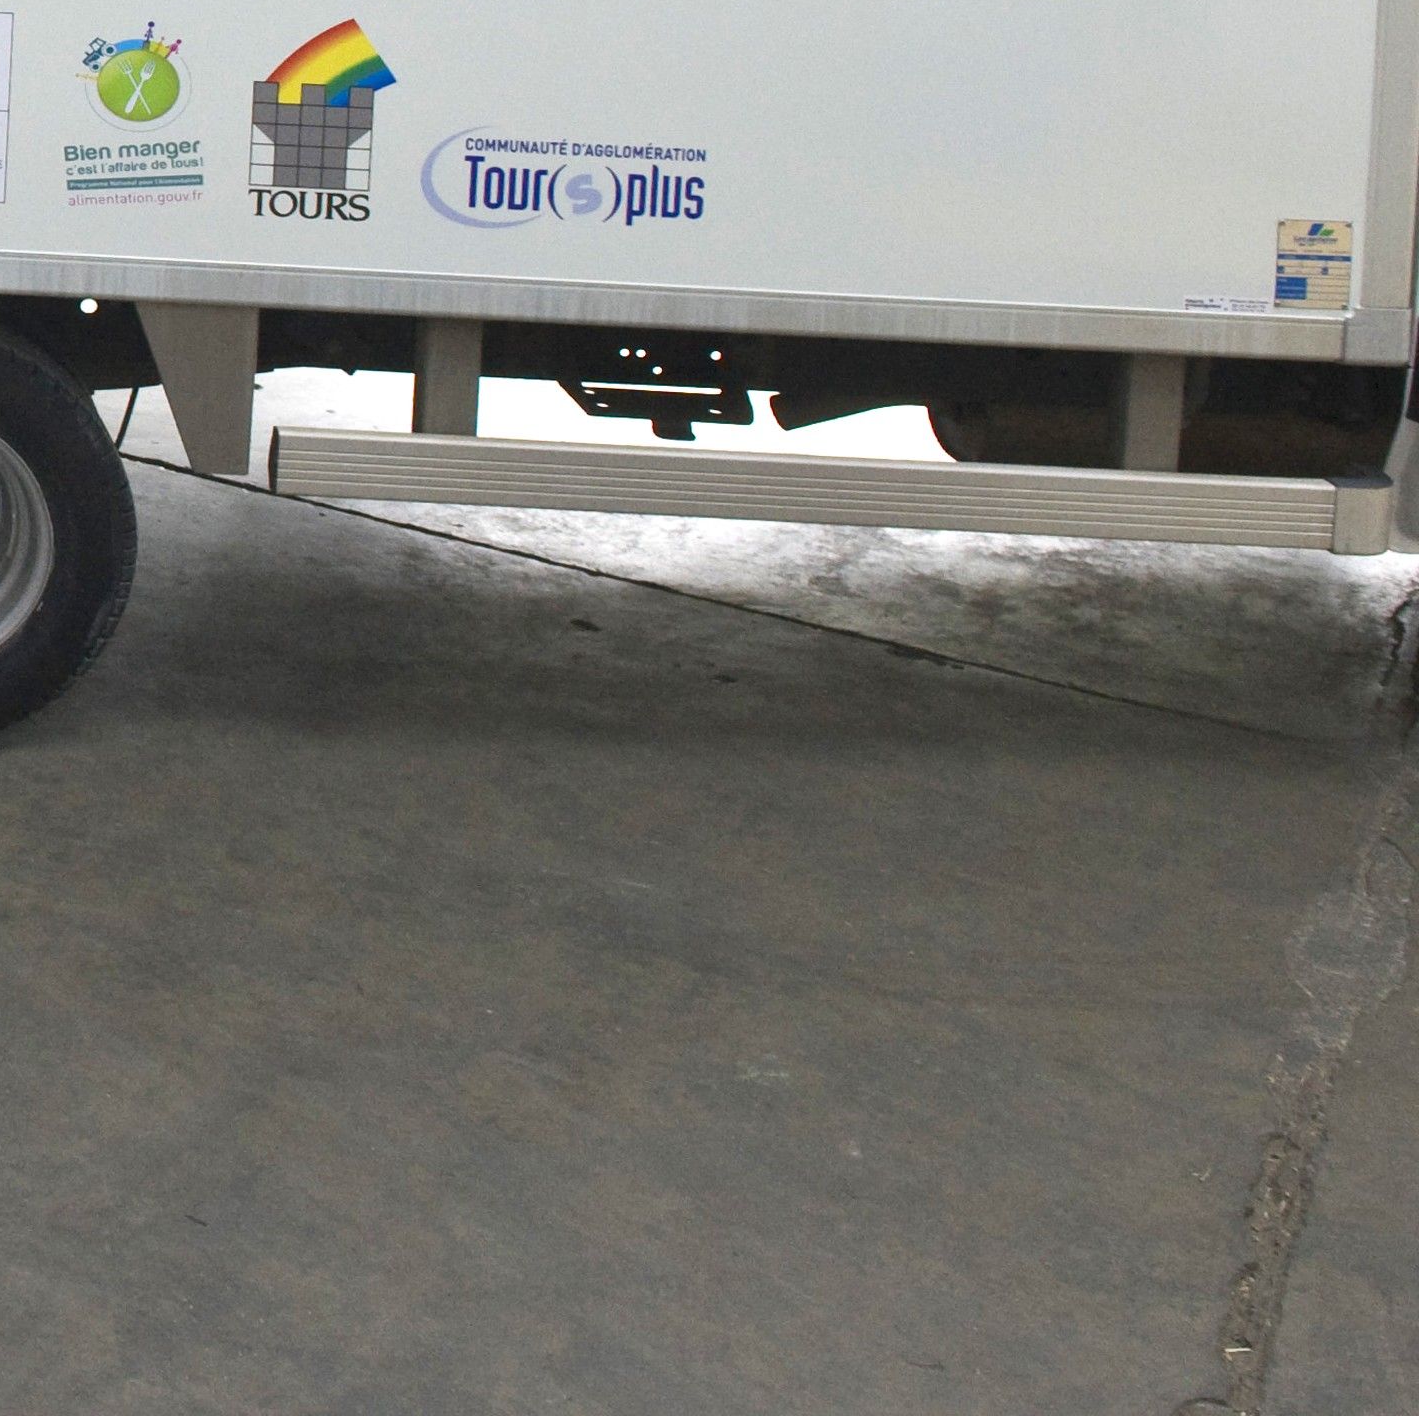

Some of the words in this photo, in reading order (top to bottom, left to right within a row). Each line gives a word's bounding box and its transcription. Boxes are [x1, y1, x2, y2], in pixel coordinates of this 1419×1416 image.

[64, 145, 112, 162] Bien
[118, 140, 201, 159] manger
[465, 137, 568, 156] COMMUNAUTÉ
[572, 142, 707, 162] D'AGGLOMÉRATION
[66, 164, 97, 176] c'est
[101, 161, 147, 173] l'affaire
[151, 160, 168, 170] de
[68, 190, 203, 207] alimentation.gouv.fr
[248, 189, 370, 222] TOURS
